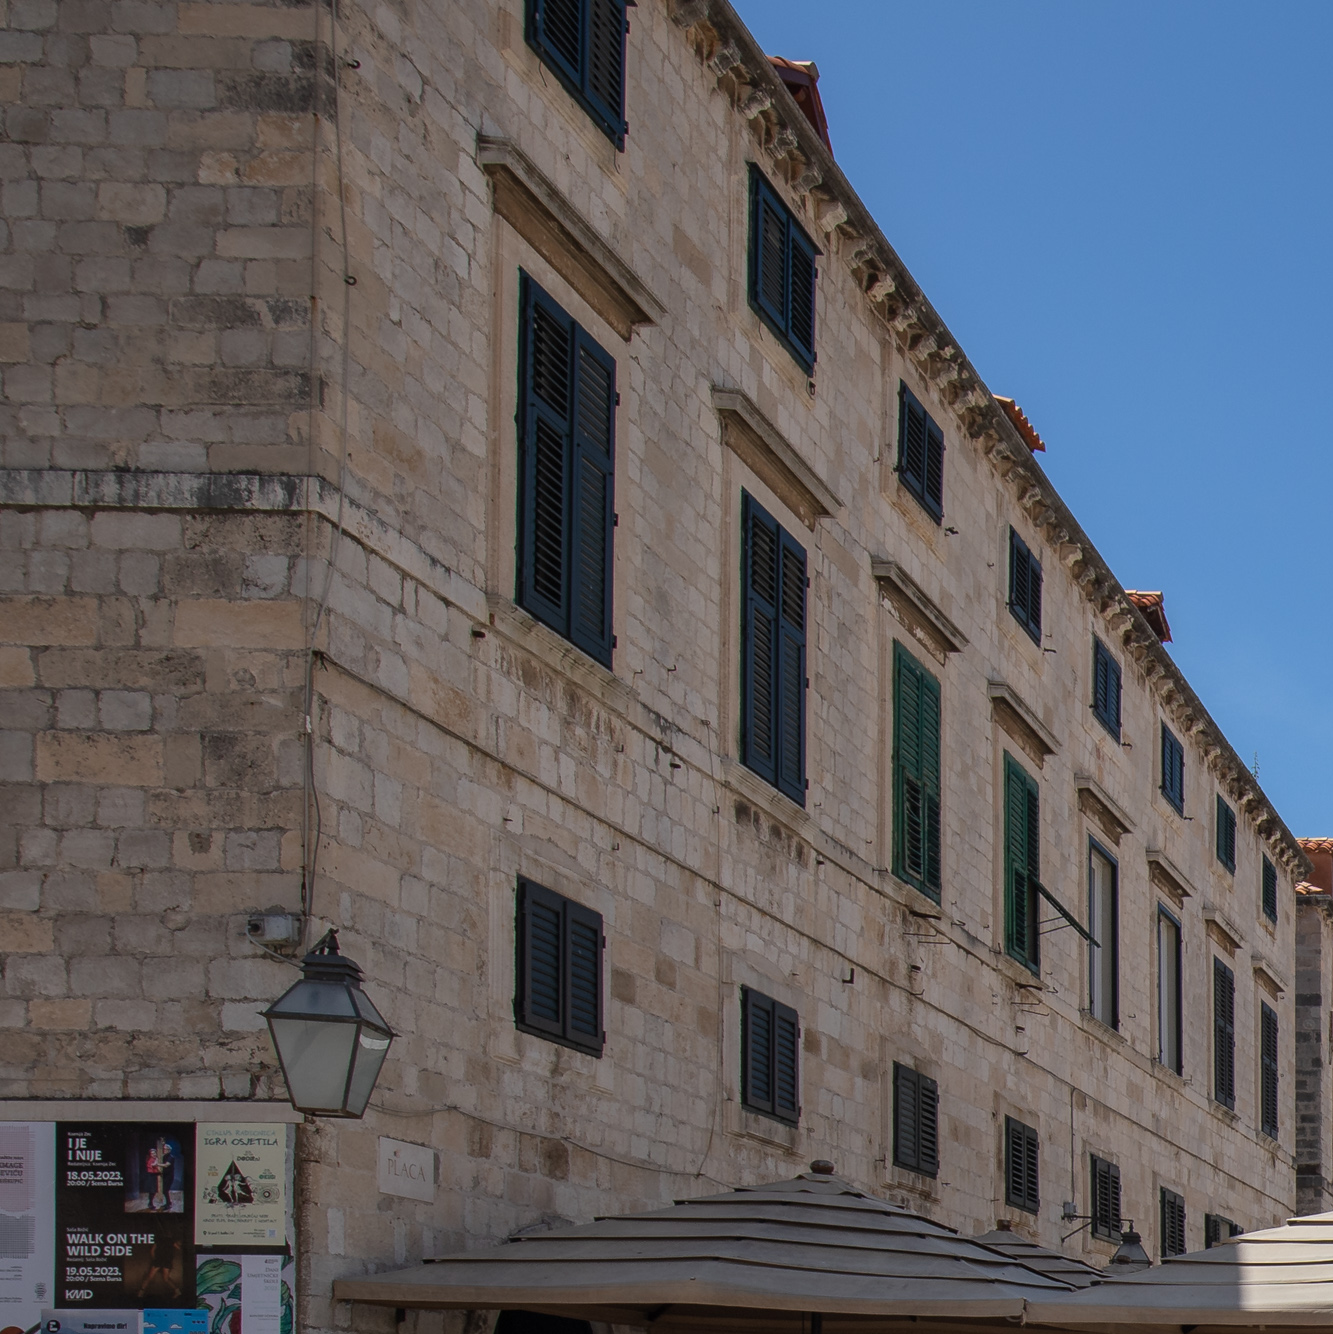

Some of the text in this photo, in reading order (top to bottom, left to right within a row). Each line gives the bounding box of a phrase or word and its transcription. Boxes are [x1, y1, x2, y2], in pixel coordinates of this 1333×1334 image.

[68, 1138, 87, 1150] I JE
[204, 1137, 278, 1146] IGRA OSJETILA
[68, 1150, 102, 1162] I NIJE
[67, 1171, 123, 1180] 18.05.2023.
[387, 1158, 426, 1182] PLACA
[66, 1233, 155, 1244] WALK ON THE
[66, 1245, 133, 1256] WILD SIDE
[65, 1266, 122, 1276] 19.05.2023.
